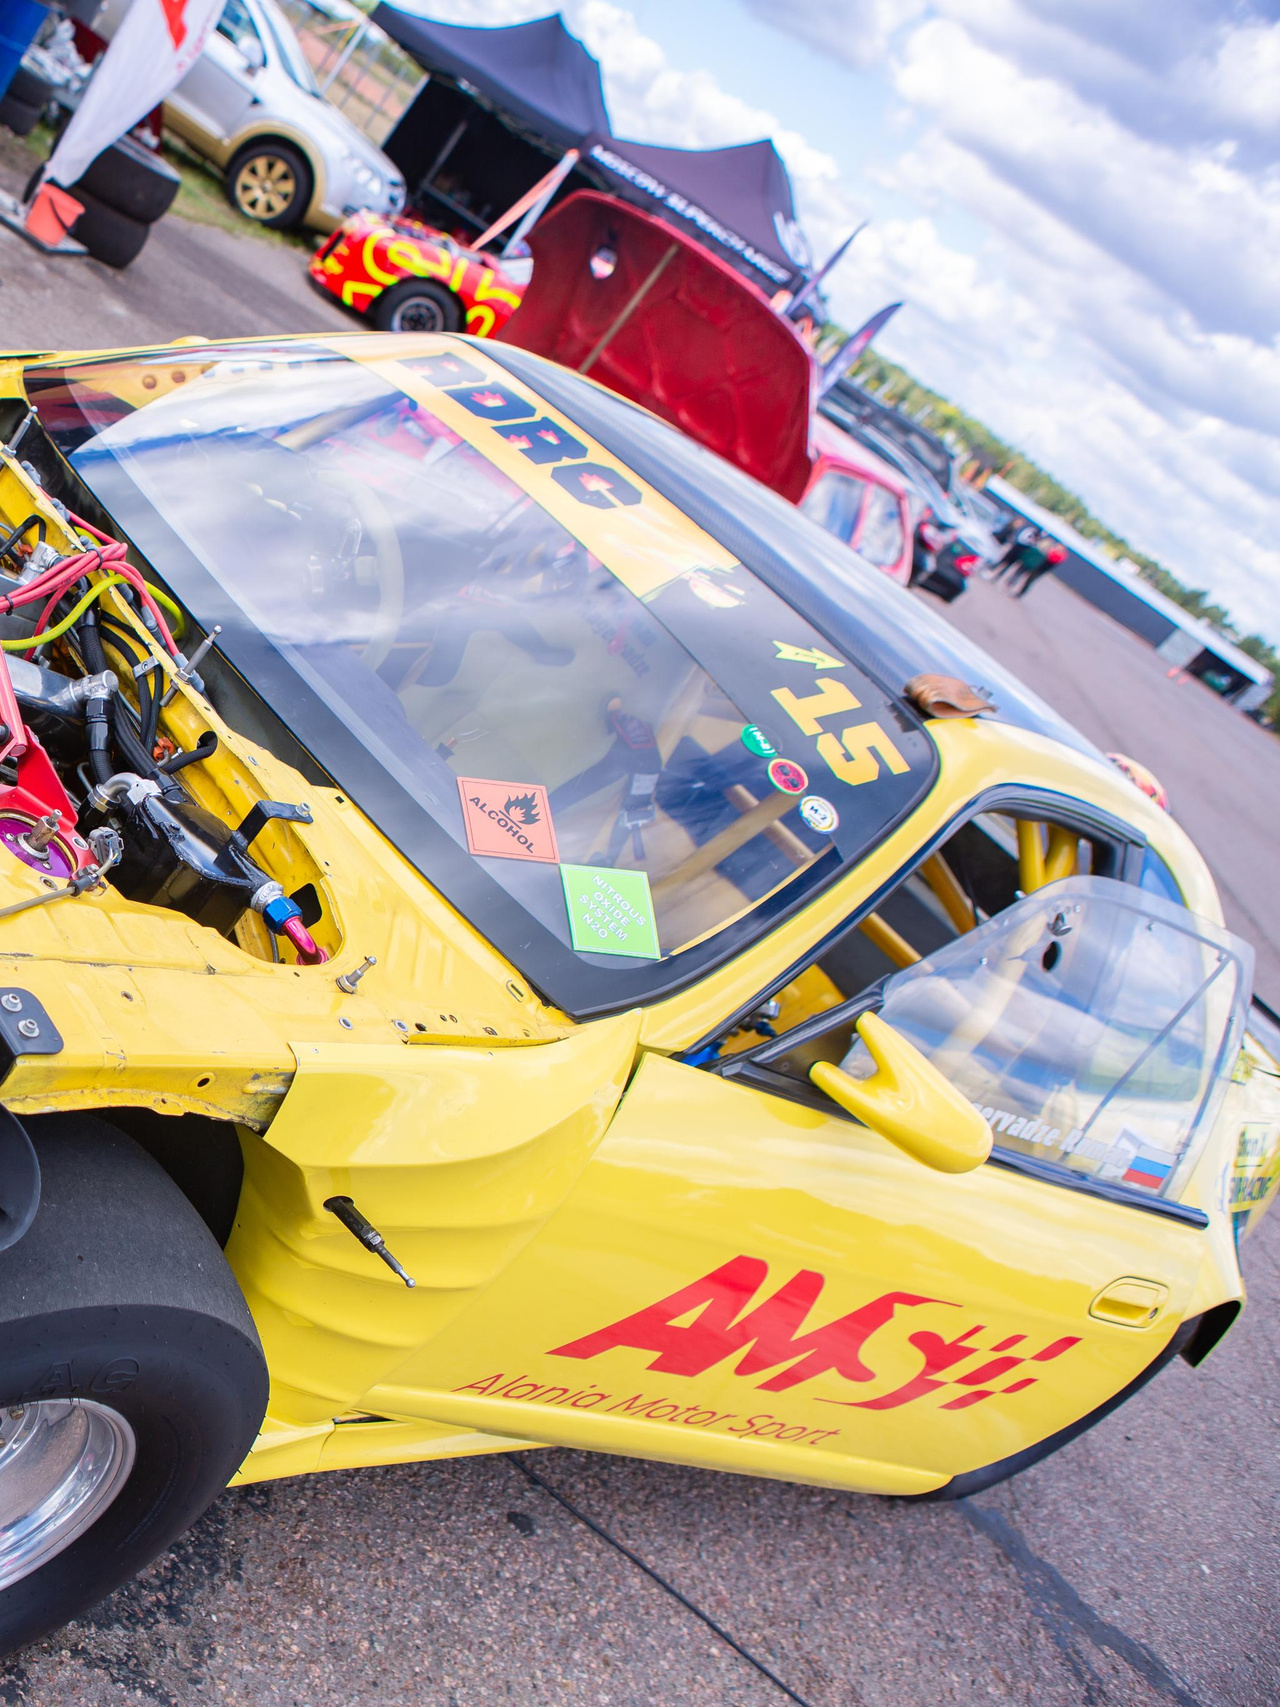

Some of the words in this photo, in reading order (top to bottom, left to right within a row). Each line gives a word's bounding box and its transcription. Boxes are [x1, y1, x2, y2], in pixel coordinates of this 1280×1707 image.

[770, 677, 911, 787] 15
[469, 795, 534, 854] ALCOHOL
[579, 893, 629, 942] SYSTEM
[582, 912, 608, 940] N2O
[592, 874, 647, 927] NITROUS
[592, 891, 631, 927] OXIDE
[544, 1254, 964, 1410] AMS
[450, 1372, 613, 1409] Alania
[604, 1393, 739, 1427] Motor
[727, 1414, 842, 1446] Sport
